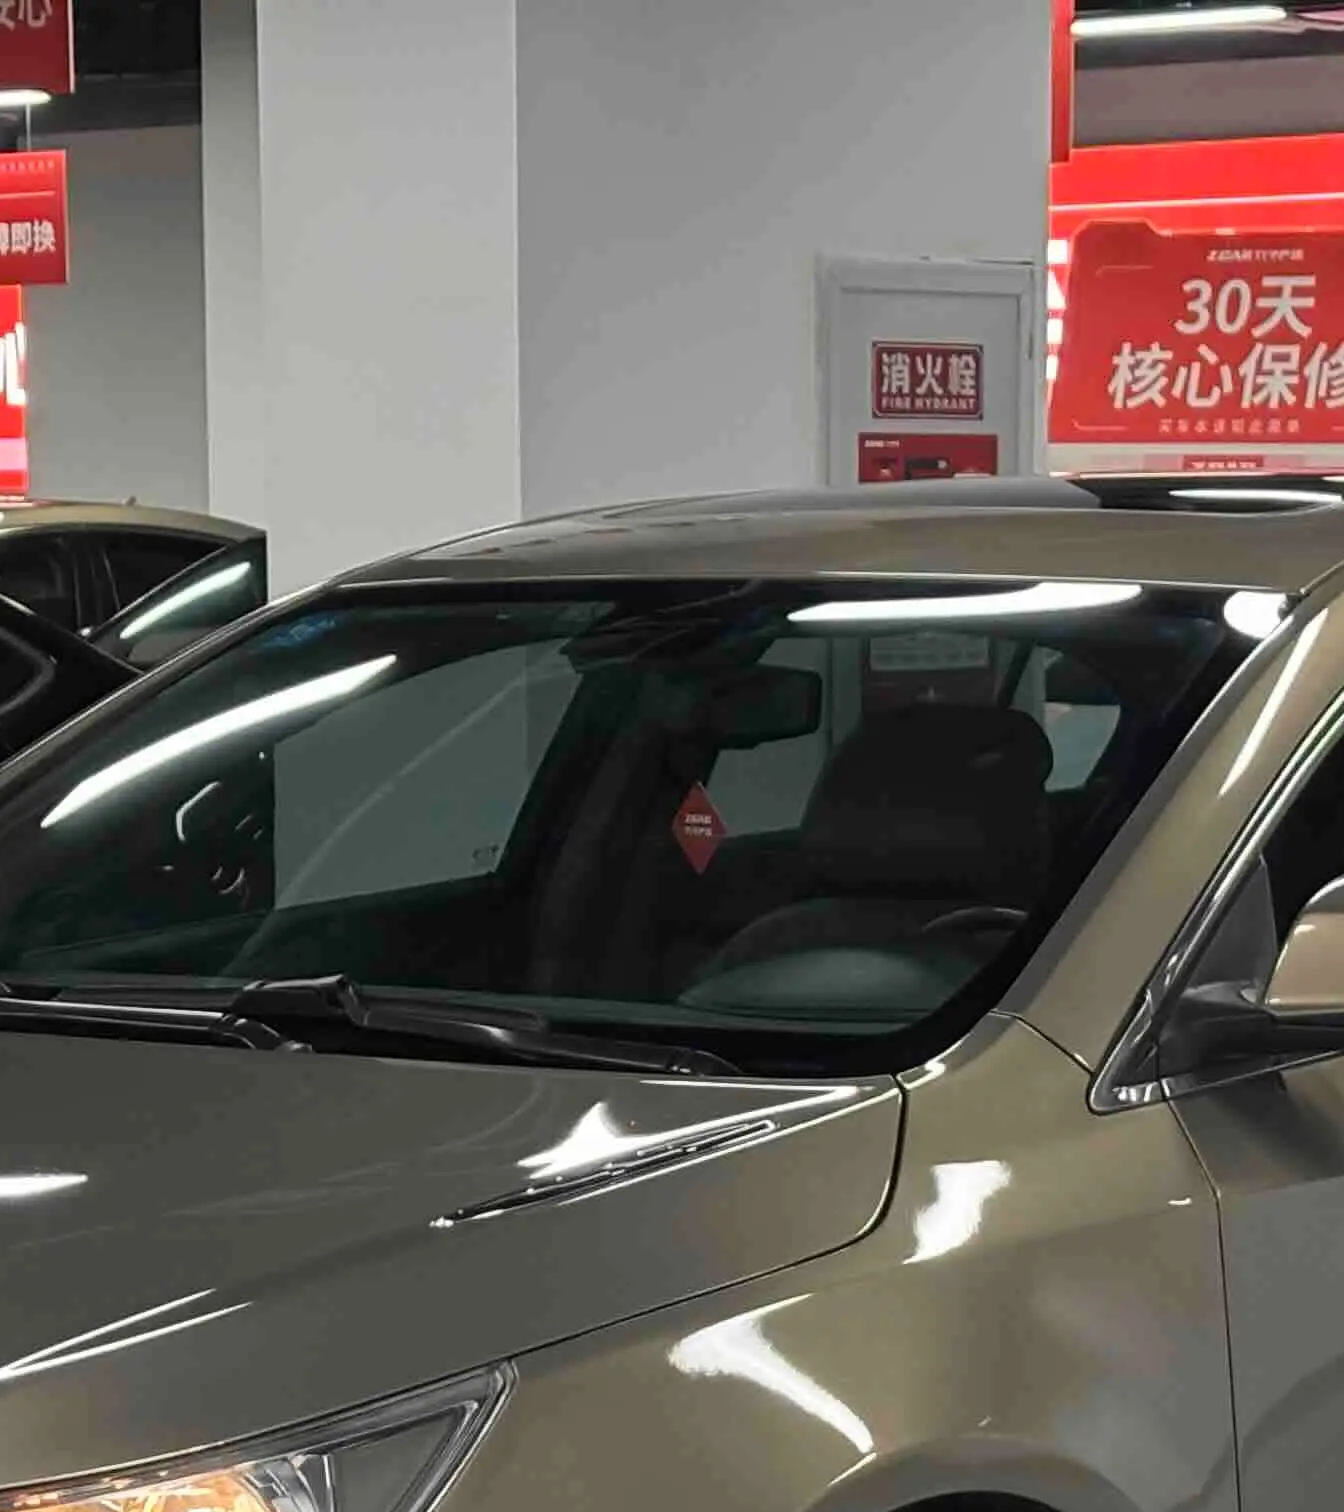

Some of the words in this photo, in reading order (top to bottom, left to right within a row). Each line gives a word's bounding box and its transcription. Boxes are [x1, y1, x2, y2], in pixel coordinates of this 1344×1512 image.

[1174, 274, 1317, 338] 30天
[881, 351, 977, 397] 消火栓
[881, 397, 912, 409] FIRE
[915, 397, 977, 410] HYDRANT
